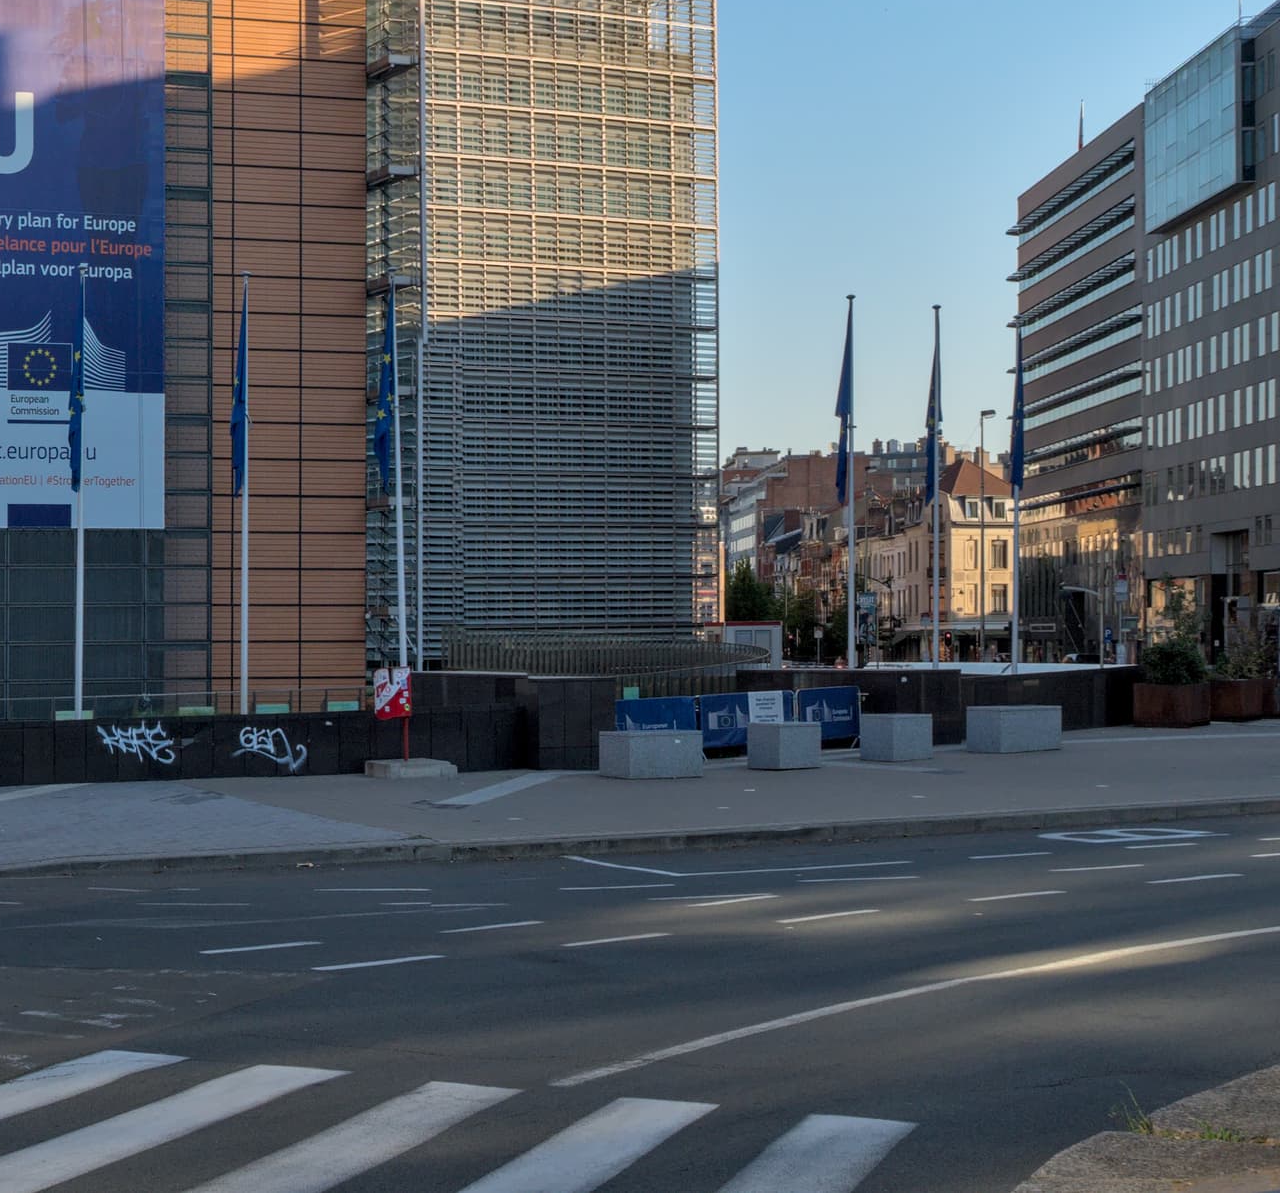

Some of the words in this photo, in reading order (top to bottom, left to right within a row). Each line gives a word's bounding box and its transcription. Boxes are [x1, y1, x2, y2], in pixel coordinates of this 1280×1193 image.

[18, 212, 52, 230] plan
[57, 213, 79, 229] for
[83, 215, 137, 234] Europe
[51, 241, 86, 255] pour
[40, 264, 75, 277] voor
[10, 394, 49, 404] European
[10, 406, 60, 416] Commission
[46, 475, 136, 487] #StroerTogether
